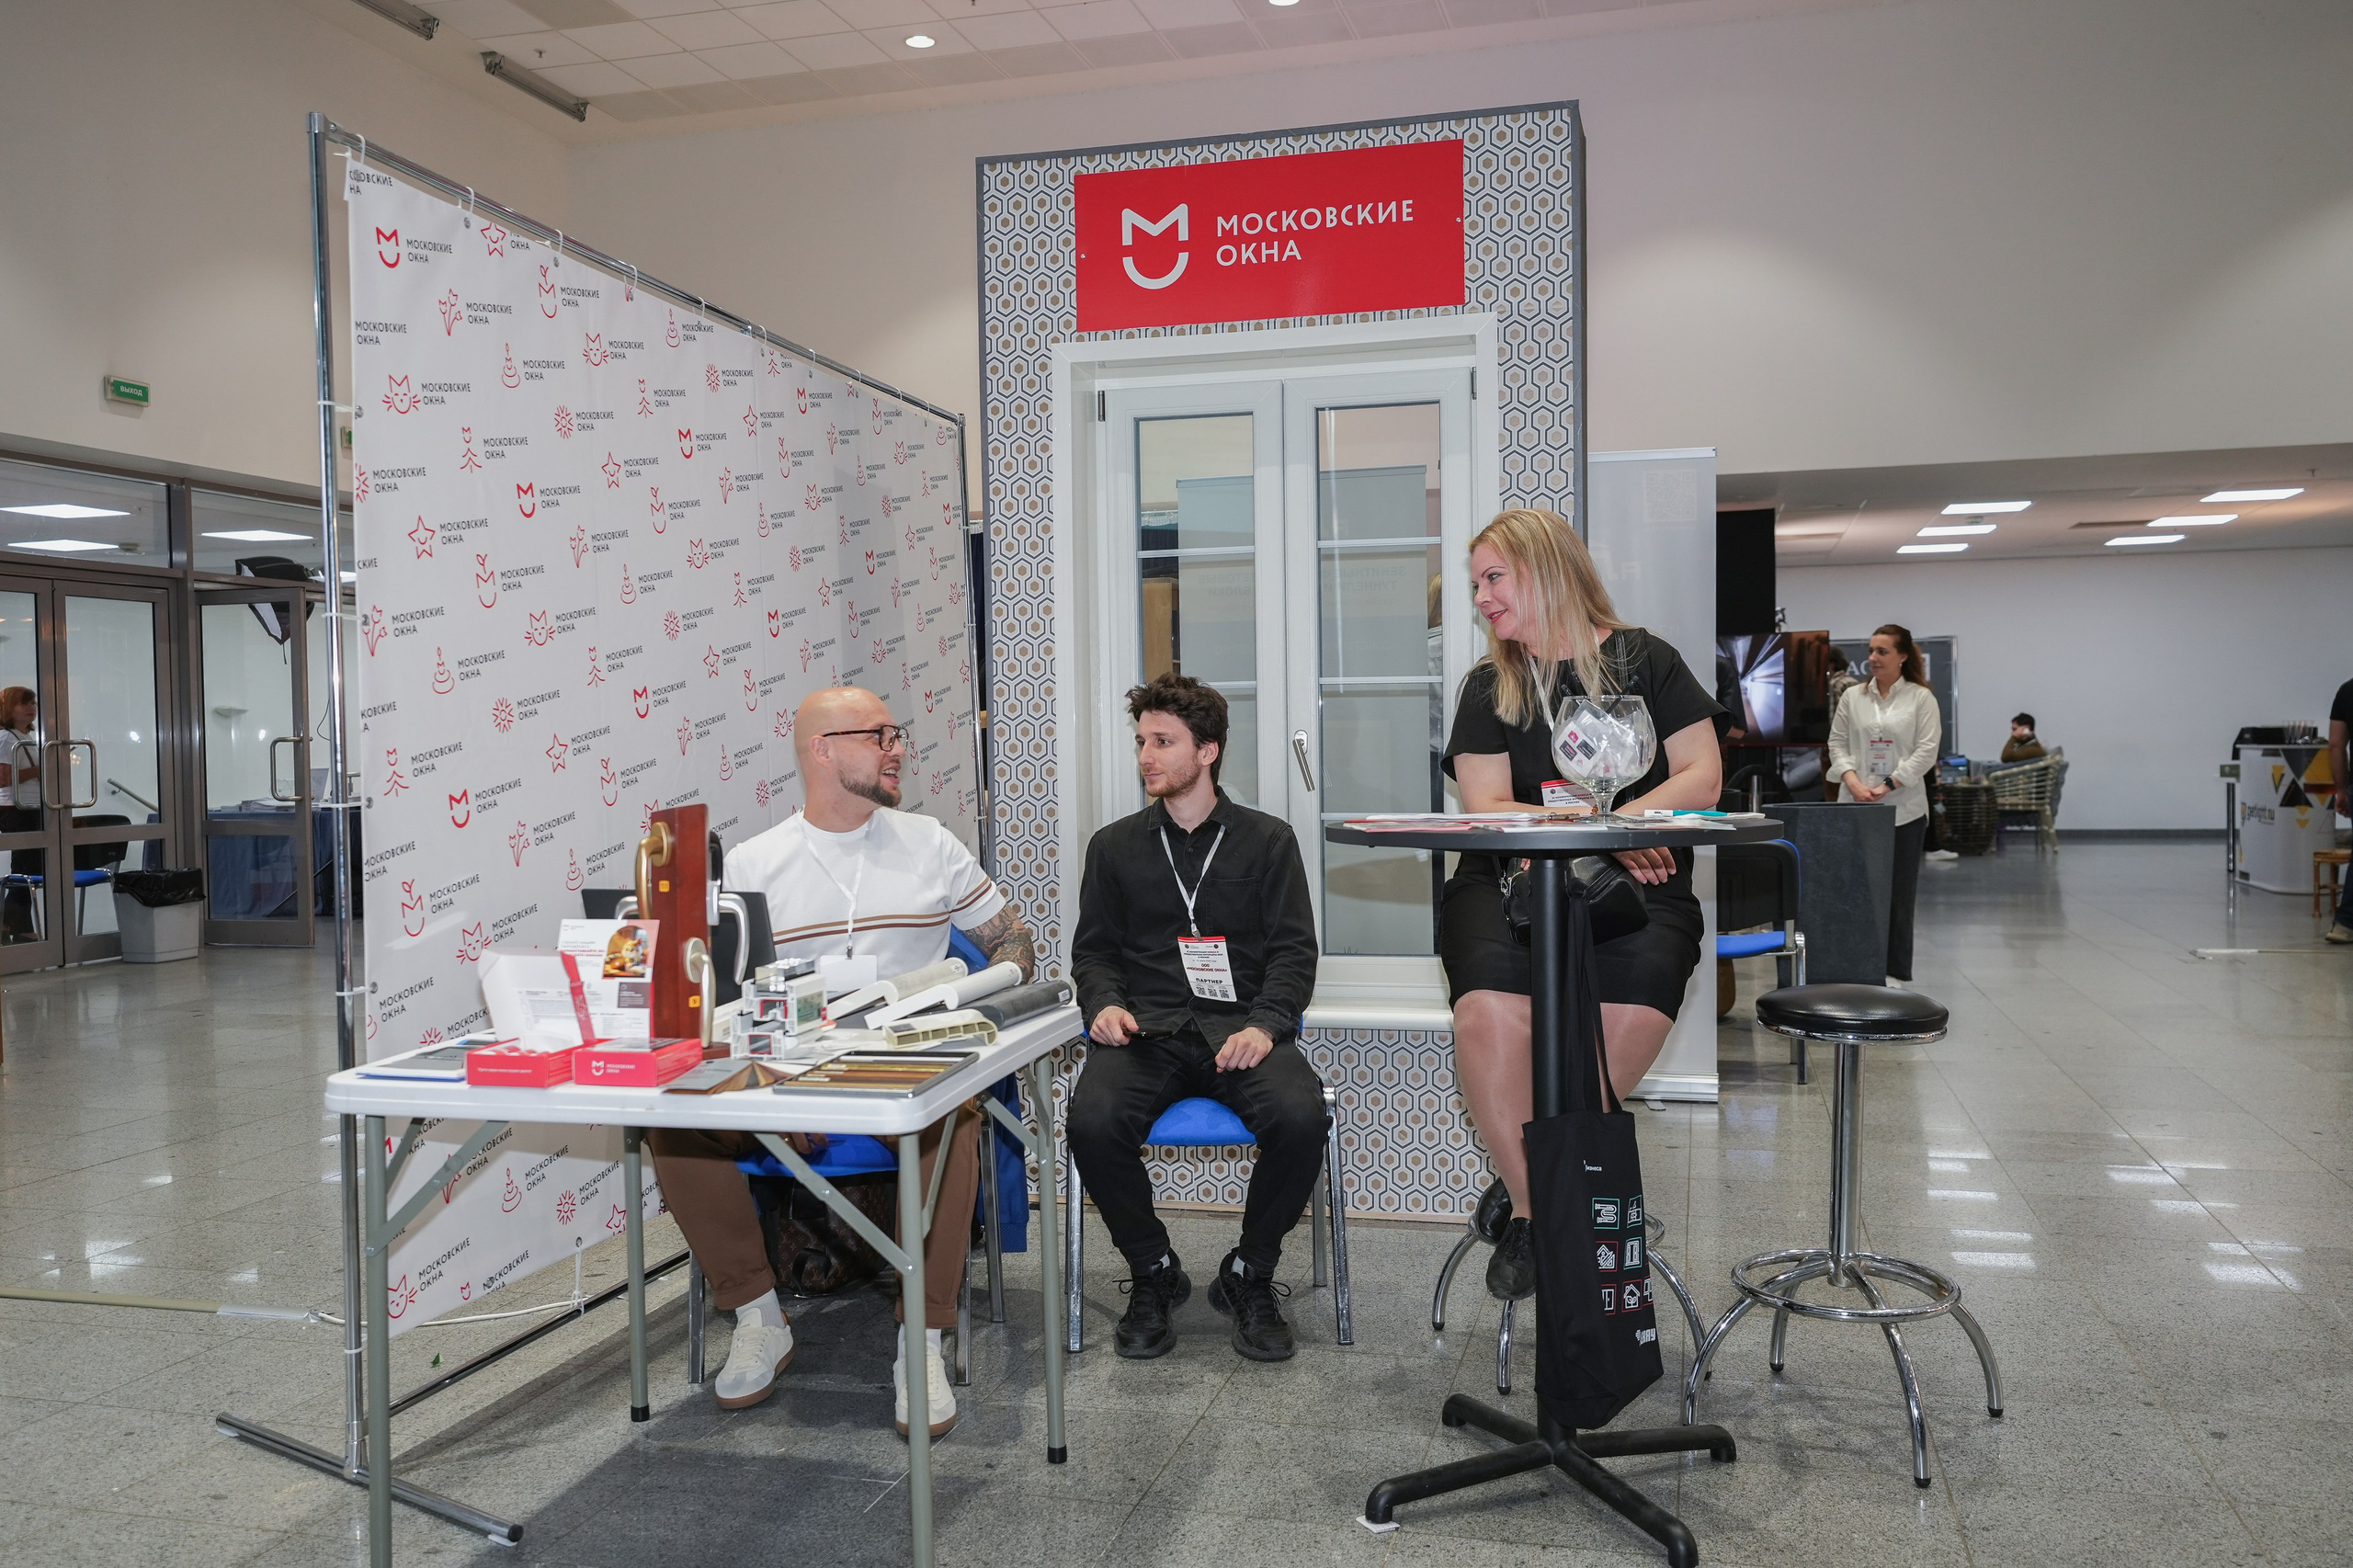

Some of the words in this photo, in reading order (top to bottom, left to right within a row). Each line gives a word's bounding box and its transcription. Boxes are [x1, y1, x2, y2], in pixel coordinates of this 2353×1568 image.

[350, 170, 392, 187] СОВСКИЕ
[1217, 199, 1414, 237] МОСКОВСКИЕ
[406, 239, 452, 254] МОСКОВСКИЕ
[511, 240, 530, 250] ОКНА
[408, 253, 429, 263] ОКНА
[1216, 239, 1302, 267] ОКНА
[561, 287, 599, 298] МОСКОВСКИЕ
[466, 302, 512, 314] МОСКОВСКИЕ
[562, 299, 579, 307] ОКНА
[468, 315, 490, 324] ОКНА
[356, 321, 406, 334] МОСКОВСКИЕ
[358, 335, 381, 345] ОКНА
[683, 334, 697, 342] ОКНА
[608, 341, 644, 349] МОСКОВСКИЕ
[523, 360, 564, 369] МОСКОВСКИЕ
[525, 371, 544, 380] ОКНА
[120, 386, 142, 396] ВЫХОД
[422, 383, 471, 392] МОСКОВСКИЕ
[423, 396, 446, 405] ОКНА
[576, 411, 614, 420] МОСКОВСКИЕ
[577, 423, 595, 431] ОКНА
[483, 437, 528, 447] МОСКОВСКИЕ
[696, 433, 727, 441] МОСКОВСКИЕ
[485, 450, 506, 460] ОКНА
[624, 457, 658, 467] МОСКОВСКИЕ
[373, 467, 426, 480] МОСКОВСКИЕ
[625, 470, 642, 478] ОКНА
[735, 472, 764, 482] МОСКОВСКИЕ
[375, 483, 399, 494] ОКНА
[540, 485, 580, 496] МОСКОВСКИЕ
[821, 485, 843, 494] МОСКОВСКИЕ
[541, 499, 560, 509] ОКНА
[668, 499, 700, 510] МОСКОВСКИЕ
[670, 512, 685, 520] ОКНА
[770, 510, 795, 520] МОСКОВСКИЕ
[439, 518, 488, 532] МОСКОВСКИЕ
[441, 534, 464, 545] ОКНА
[591, 529, 629, 542] МОСКОВСКИЕ
[593, 544, 609, 553] ОКНА
[710, 539, 739, 550] МОСКОВСКИЕ
[802, 544, 825, 555] МОСКОВСКИЕ
[710, 551, 724, 560] ОКНА
[803, 556, 814, 564] ОКНА
[501, 565, 544, 580] МОСКОВСКИЕ
[638, 570, 673, 584] МОСКОВСКИЕ
[747, 574, 774, 585] МОСКОВСКИЕ
[502, 581, 522, 592] ОКНА
[640, 585, 655, 594] ОКНА
[748, 587, 761, 596] ОКНА
[392, 607, 444, 624] МОСКОВСКИЕ
[556, 607, 596, 622] МОСКОВСКИЕ
[682, 608, 713, 621] МОСКОВСКИЕ
[781, 607, 806, 619] МОСКОВСКИЕ
[557, 623, 575, 634] ОКНА
[683, 621, 698, 631] ОКНА
[782, 620, 794, 629] ОКНА
[393, 625, 418, 637] ОКНА
[606, 645, 642, 662] МОСКОВСКИЕ
[722, 642, 751, 655] МОСКОВСКИЕ
[458, 650, 505, 669] МОСКОВСКИЕ
[723, 656, 736, 665] ОКНА
[608, 662, 624, 672] ОКНА
[460, 668, 481, 681] ОКНА
[759, 673, 785, 687] МОСКОВСКИЕ
[653, 680, 686, 697] МОСКОВСКИЕ
[760, 687, 772, 697] ОКНА
[517, 689, 560, 709] МОСКОВСКИЕ
[654, 697, 669, 708] ОКНА
[518, 709, 539, 721] ОКНА
[695, 713, 726, 730] МОСКОВСКИЕ
[571, 726, 610, 744] МОСКОВСКИЕ
[696, 729, 710, 740] ОКНА
[412, 742, 462, 765] МОСКОВСКИЕ
[573, 744, 591, 756] ОКНА
[734, 743, 763, 760] МОСКОВСКИЕ
[620, 758, 656, 778] МОСКОВСКИЕ
[735, 758, 748, 769] ОКНА
[413, 763, 437, 778] ОКНА
[621, 777, 639, 789] ОКНА
[770, 770, 796, 788] МОСКОВСКИЕ
[475, 778, 521, 801] МОСКОВСКИЕ
[771, 786, 783, 796] ОКНА
[665, 789, 699, 806] МОСКОВСКИЕ
[477, 800, 498, 813] ОКНА
[533, 812, 575, 835] МОСКОВСКИЕ
[535, 833, 554, 846] ОКНА
[586, 842, 625, 865] МОСКОВСКИЕ
[587, 862, 605, 876] ОКНА
[429, 874, 480, 902] МОСКОВСКИЕ
[431, 898, 454, 914] ОКНА
[492, 903, 538, 931] МОСКОВСКИЕ
[494, 927, 515, 943] ОКНА
[380, 977, 434, 1010] МОСКОВСКИЕ
[381, 1005, 406, 1022] ОКНА
[467, 1156, 489, 1176] ОКНА
[525, 1144, 569, 1180] МОСКОВСКИЕ
[527, 1173, 546, 1191] ОКНА
[579, 1160, 619, 1195] МОСКОВСКИЕ
[581, 1187, 599, 1205] ОКНА
[419, 1237, 470, 1280] МОСКОВСКИЕ
[483, 1250, 529, 1290] МСКОВСКИЕ
[420, 1270, 443, 1291] ОКНА
